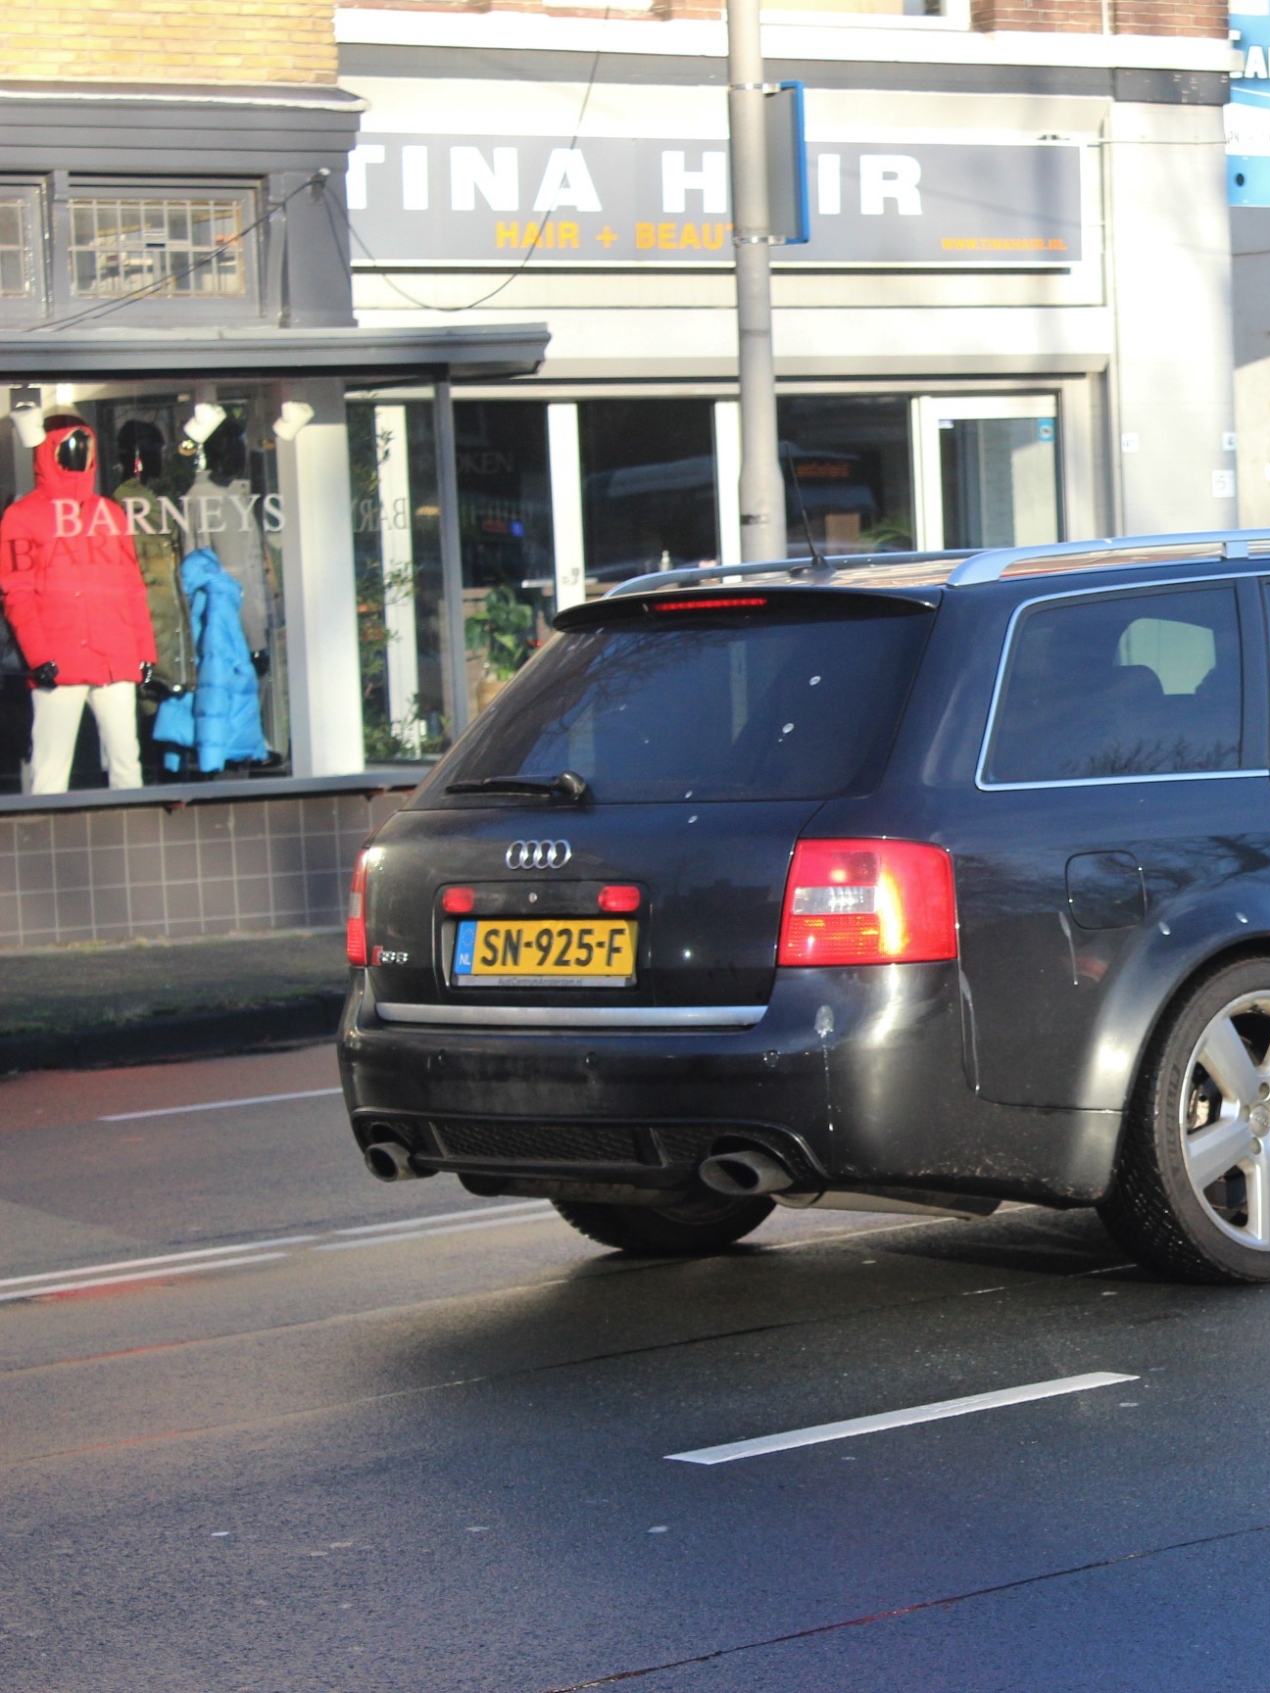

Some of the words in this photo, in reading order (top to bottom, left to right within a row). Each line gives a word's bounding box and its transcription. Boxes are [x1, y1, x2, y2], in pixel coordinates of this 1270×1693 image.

[347, 145, 603, 212] TINA
[662, 151, 923, 216] HIR
[496, 221, 579, 249] HAIR
[635, 222, 736, 250] BEAU
[51, 494, 287, 537] BARNEYS
[459, 953, 471, 966] NL
[481, 928, 626, 967] SN-925-F
